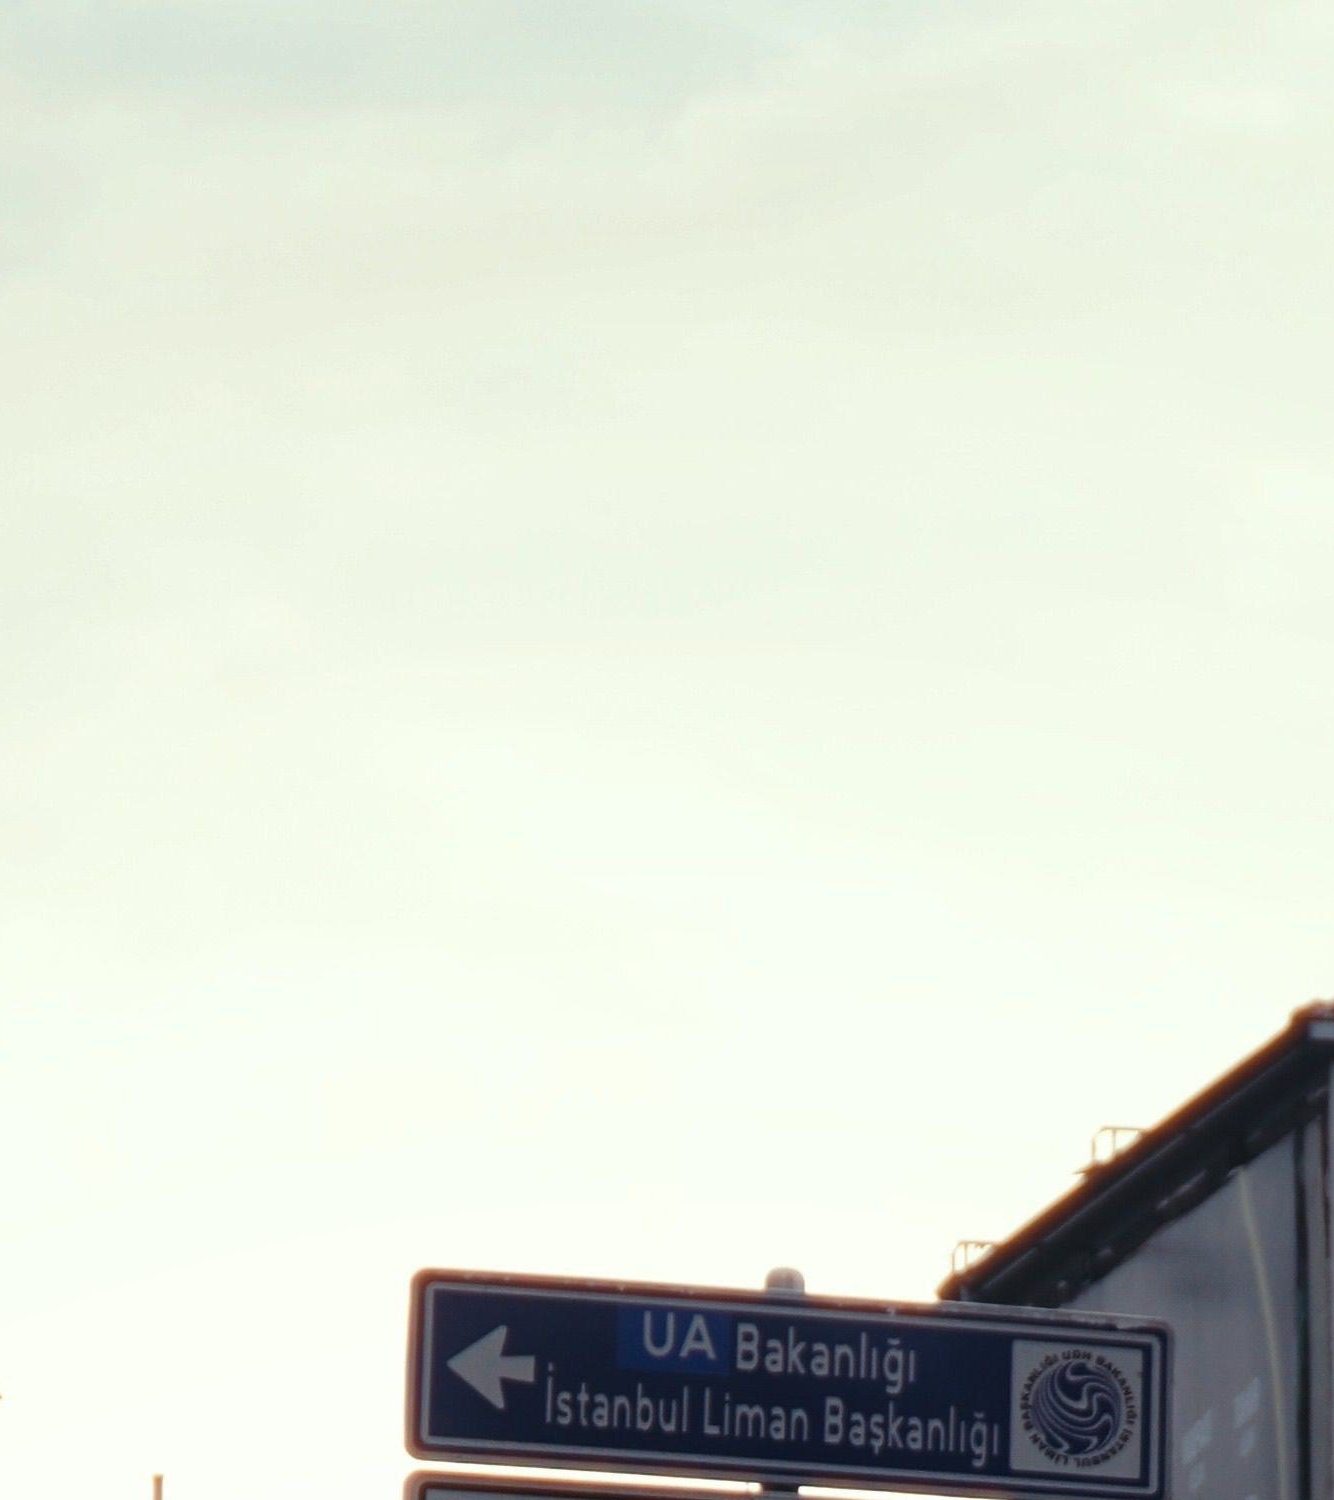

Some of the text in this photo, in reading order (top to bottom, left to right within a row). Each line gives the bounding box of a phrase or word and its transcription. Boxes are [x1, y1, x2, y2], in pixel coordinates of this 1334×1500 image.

[641, 1311, 917, 1395] UA Bakanlığı
[544, 1364, 1001, 1468] İstanbul Liman Başkanlığı
